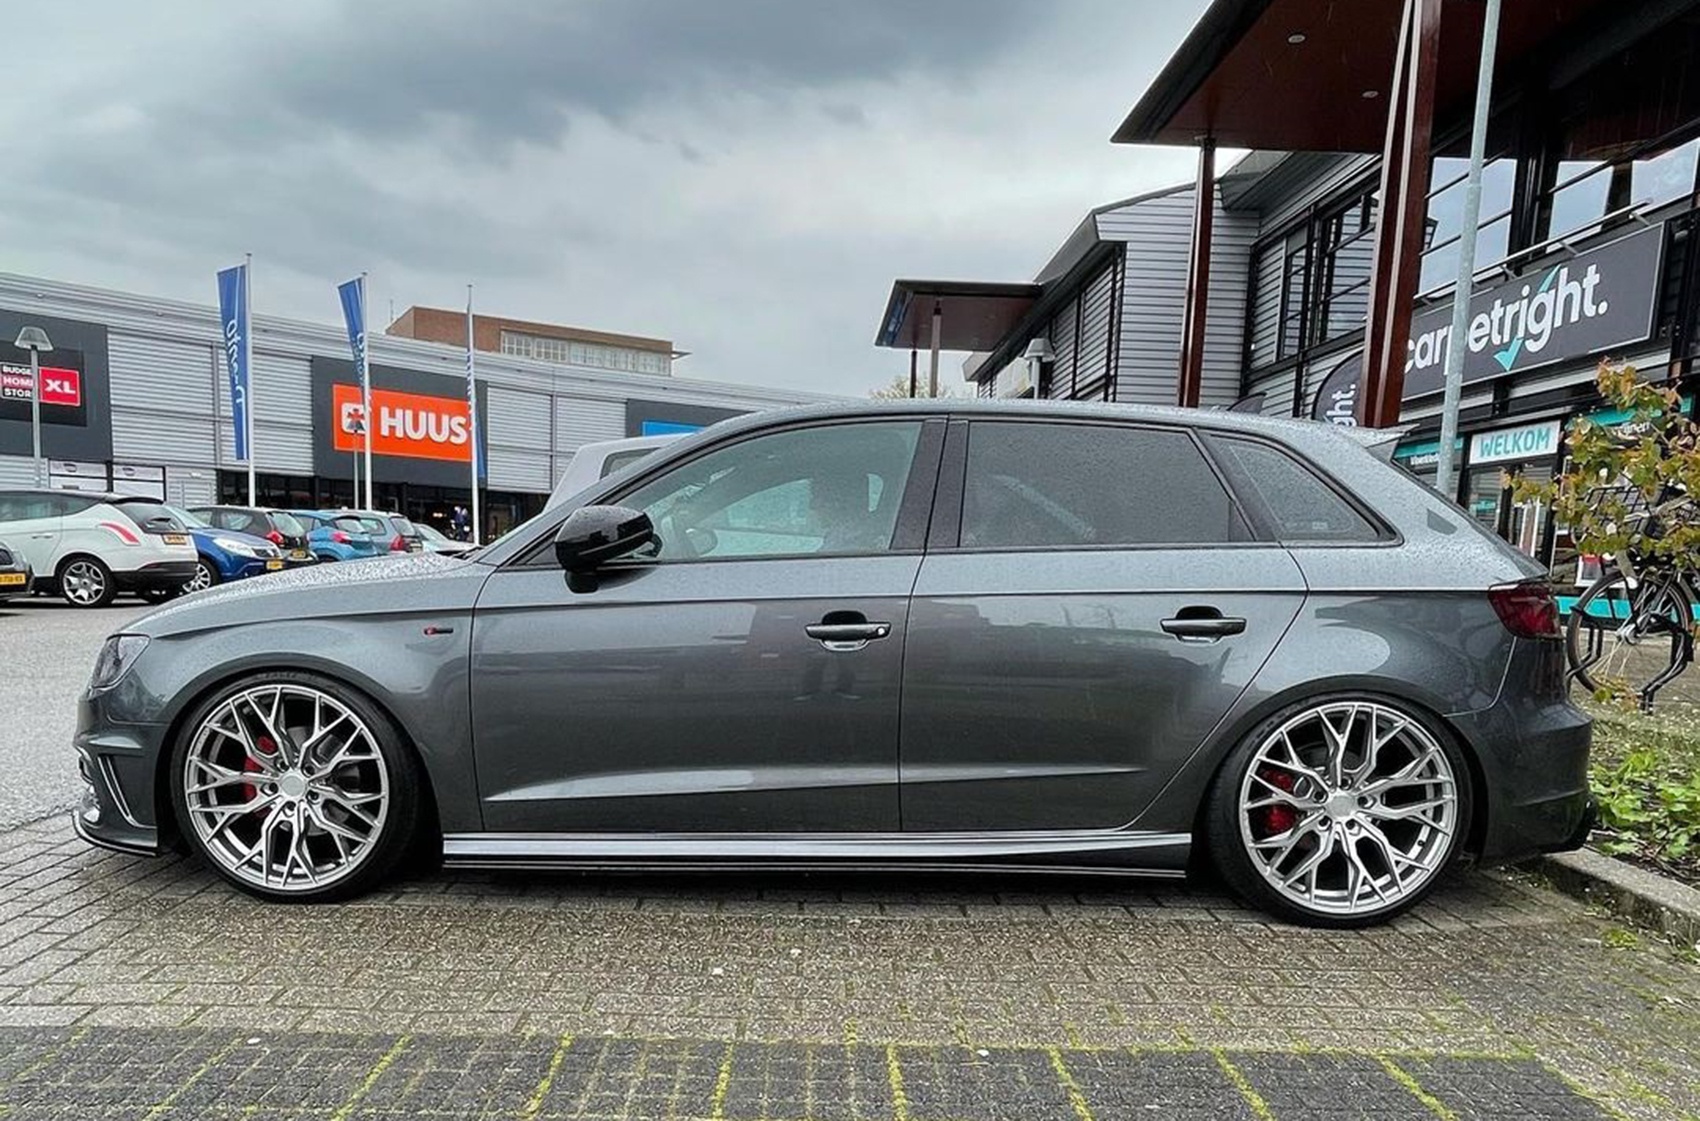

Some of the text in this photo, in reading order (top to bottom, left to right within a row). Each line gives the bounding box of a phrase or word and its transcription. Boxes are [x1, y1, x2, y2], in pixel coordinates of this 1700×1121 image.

[3, 366, 32, 375] BUDGE
[4, 388, 31, 398] STOR
[44, 379, 76, 395] XL
[380, 405, 468, 445] HUUS
[1480, 427, 1551, 458] WELKOM
